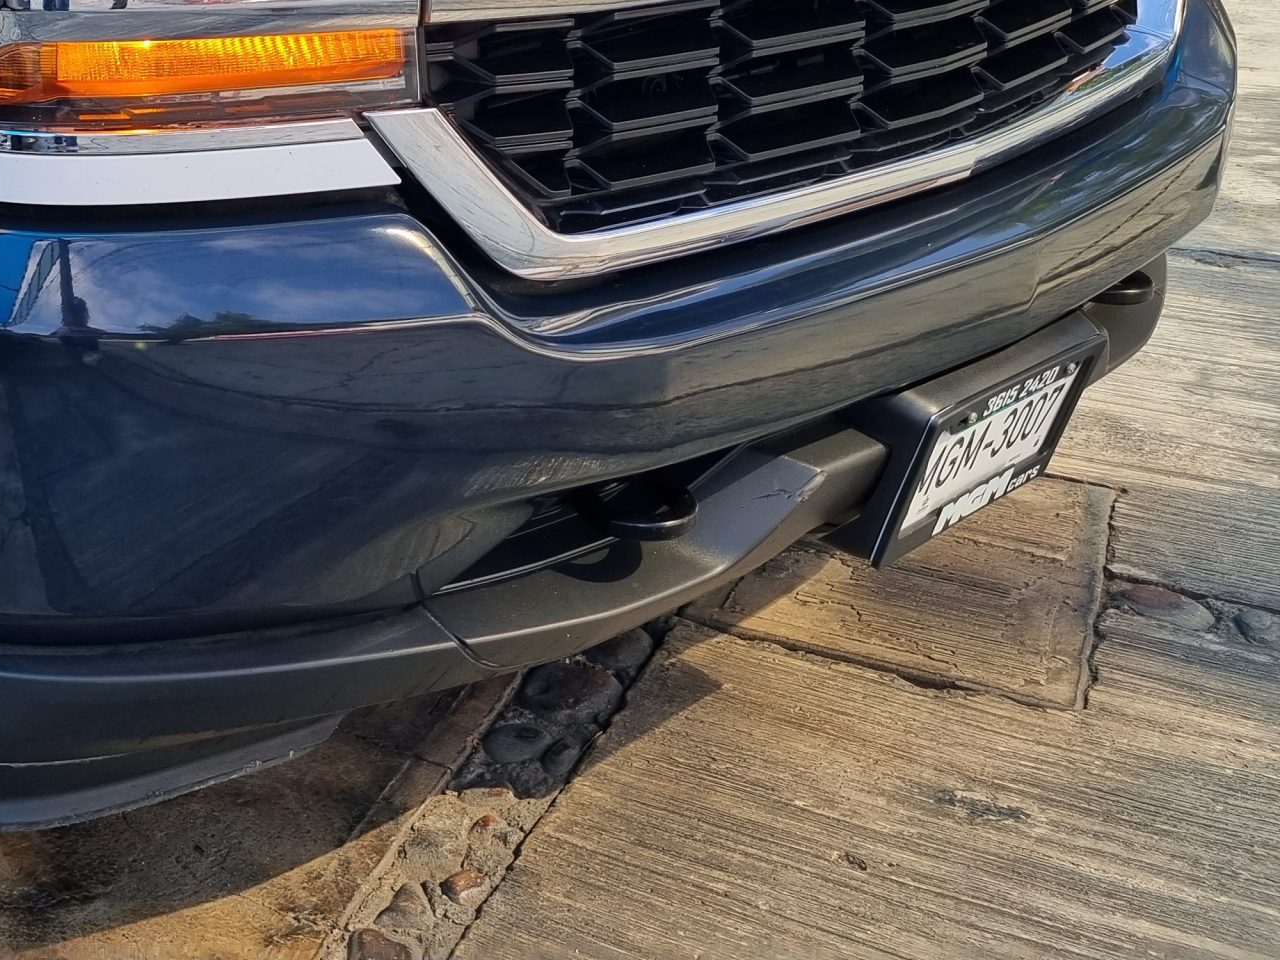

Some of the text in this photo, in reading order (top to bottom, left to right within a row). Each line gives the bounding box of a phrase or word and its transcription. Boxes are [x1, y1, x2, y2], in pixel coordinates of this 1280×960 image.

[982, 365, 1060, 417] 3615 2420
[931, 464, 1041, 537] MGM cars
